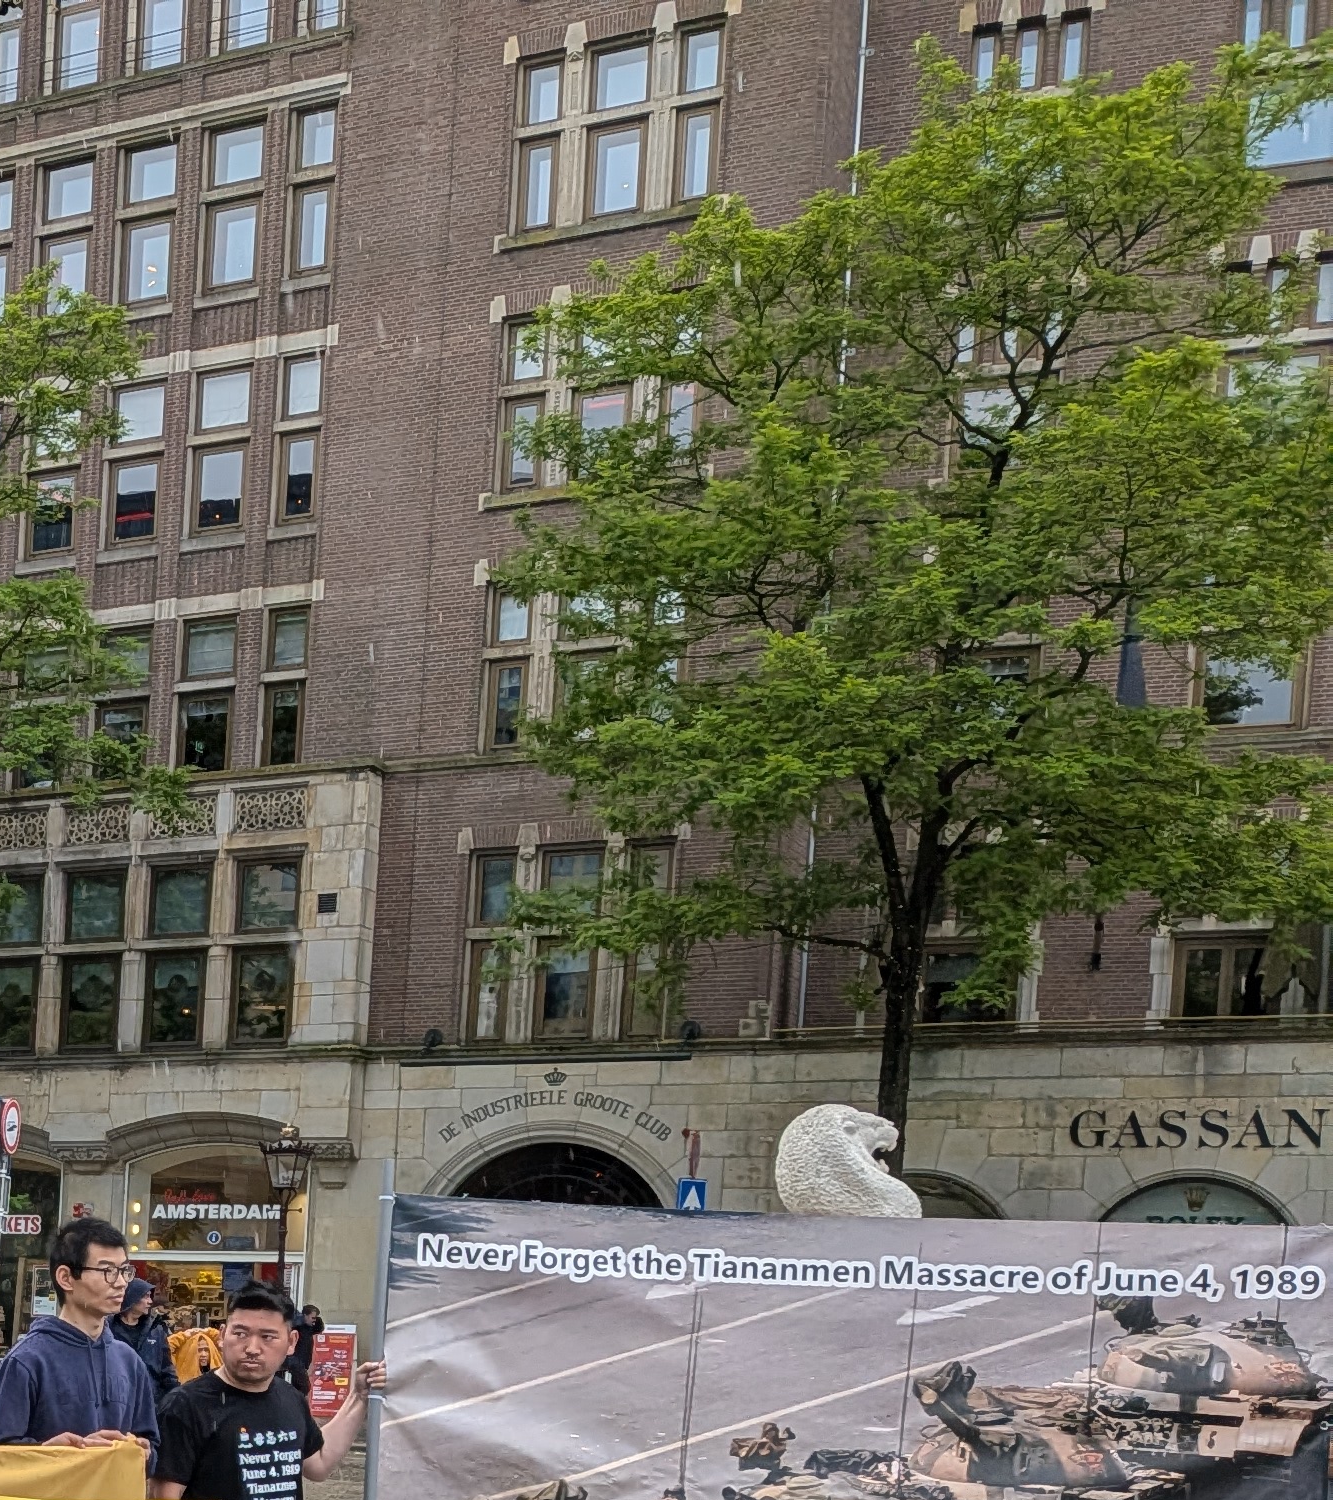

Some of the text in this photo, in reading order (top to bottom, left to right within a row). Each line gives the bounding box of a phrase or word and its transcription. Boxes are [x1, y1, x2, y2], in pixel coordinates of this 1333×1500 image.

[438, 1089, 673, 1144] DE INDUSTRIEELE GROOTE CLUB
[1068, 1108, 1331, 1150] GASSAN
[151, 1203, 282, 1220] AMSTERDAM
[4, 1215, 42, 1234] KETS
[418, 1236, 1324, 1301] Never Forget the Tiananmen Massacre of June 4, 1989
[238, 1452, 272, 1466] Never
[241, 1467, 267, 1482] June
[268, 1465, 281, 1478] 4,
